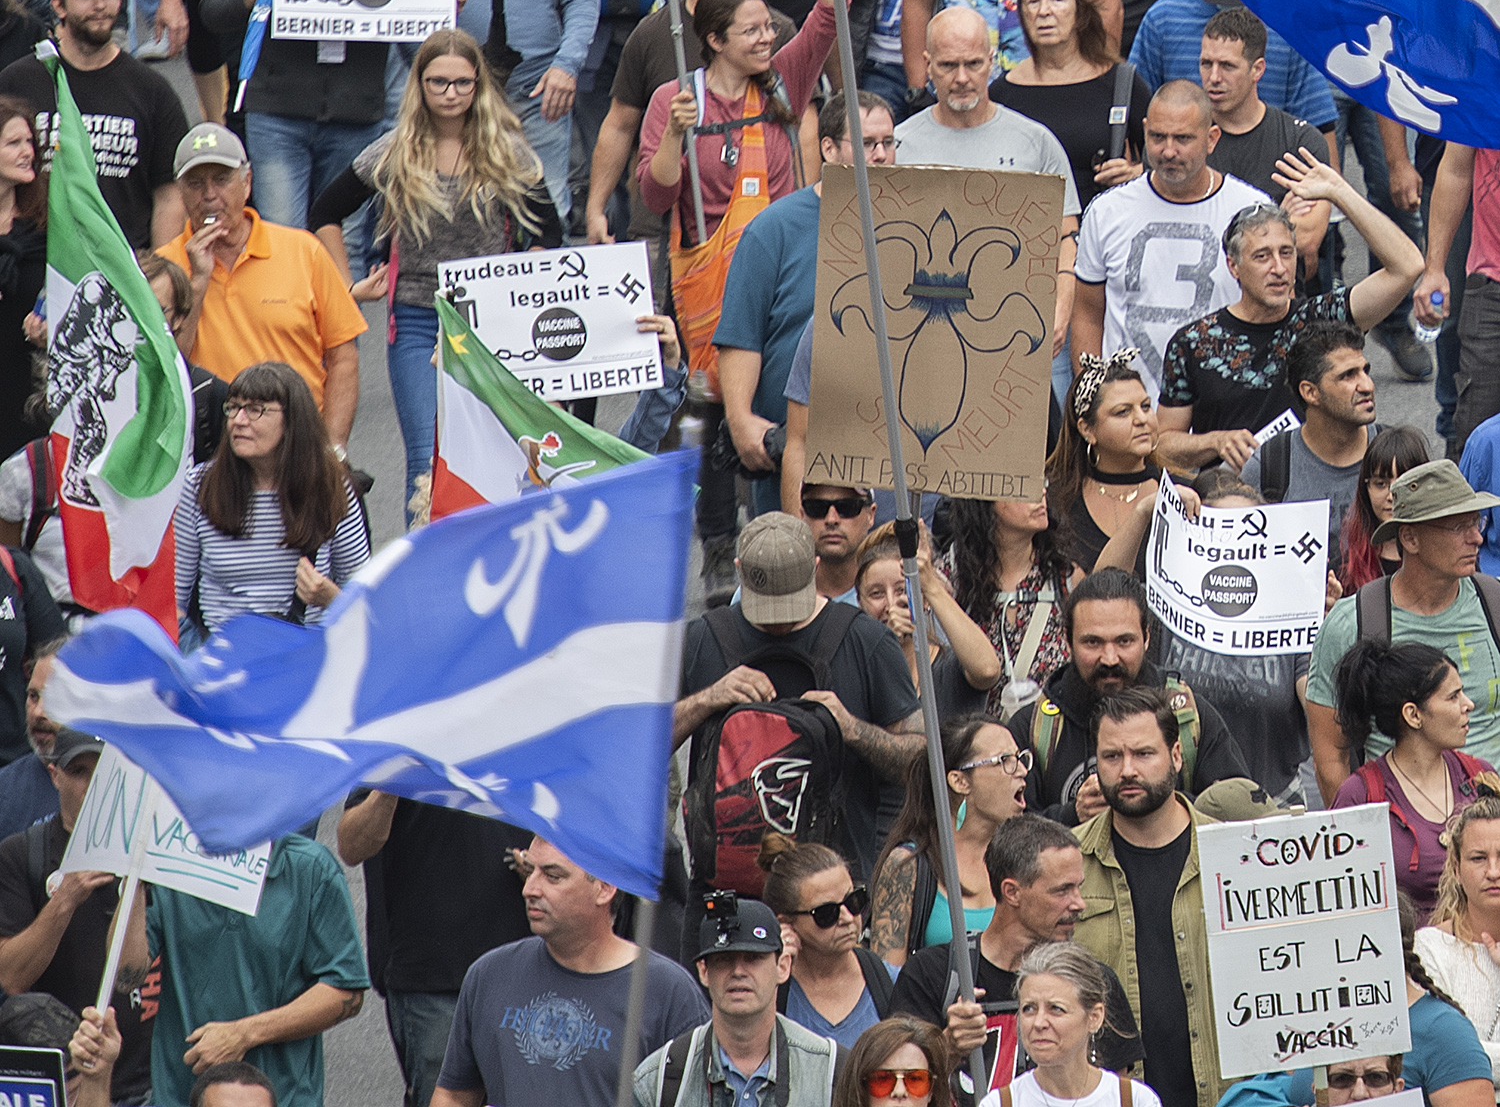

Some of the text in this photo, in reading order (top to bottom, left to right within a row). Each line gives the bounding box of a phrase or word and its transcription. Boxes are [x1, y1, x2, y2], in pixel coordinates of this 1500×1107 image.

[276, 17, 354, 34] BERNIER
[375, 13, 451, 35] LIBERTÉ
[444, 259, 534, 281] trudeau
[509, 283, 591, 309] legault
[537, 316, 581, 333] VACCINE
[535, 333, 586, 351] PASSPORT
[570, 361, 658, 395] LIBERTÉ
[940, 350, 1040, 467] MEURT
[807, 453, 873, 483] ANTI
[1188, 537, 1267, 562] legault
[1209, 574, 1253, 588] VACCINE
[1204, 589, 1256, 605] PASSPORT
[1147, 585, 1206, 641] BERNIER
[1231, 621, 1318, 649] LIBERTÉ
[1259, 934, 1382, 972] EST LA
